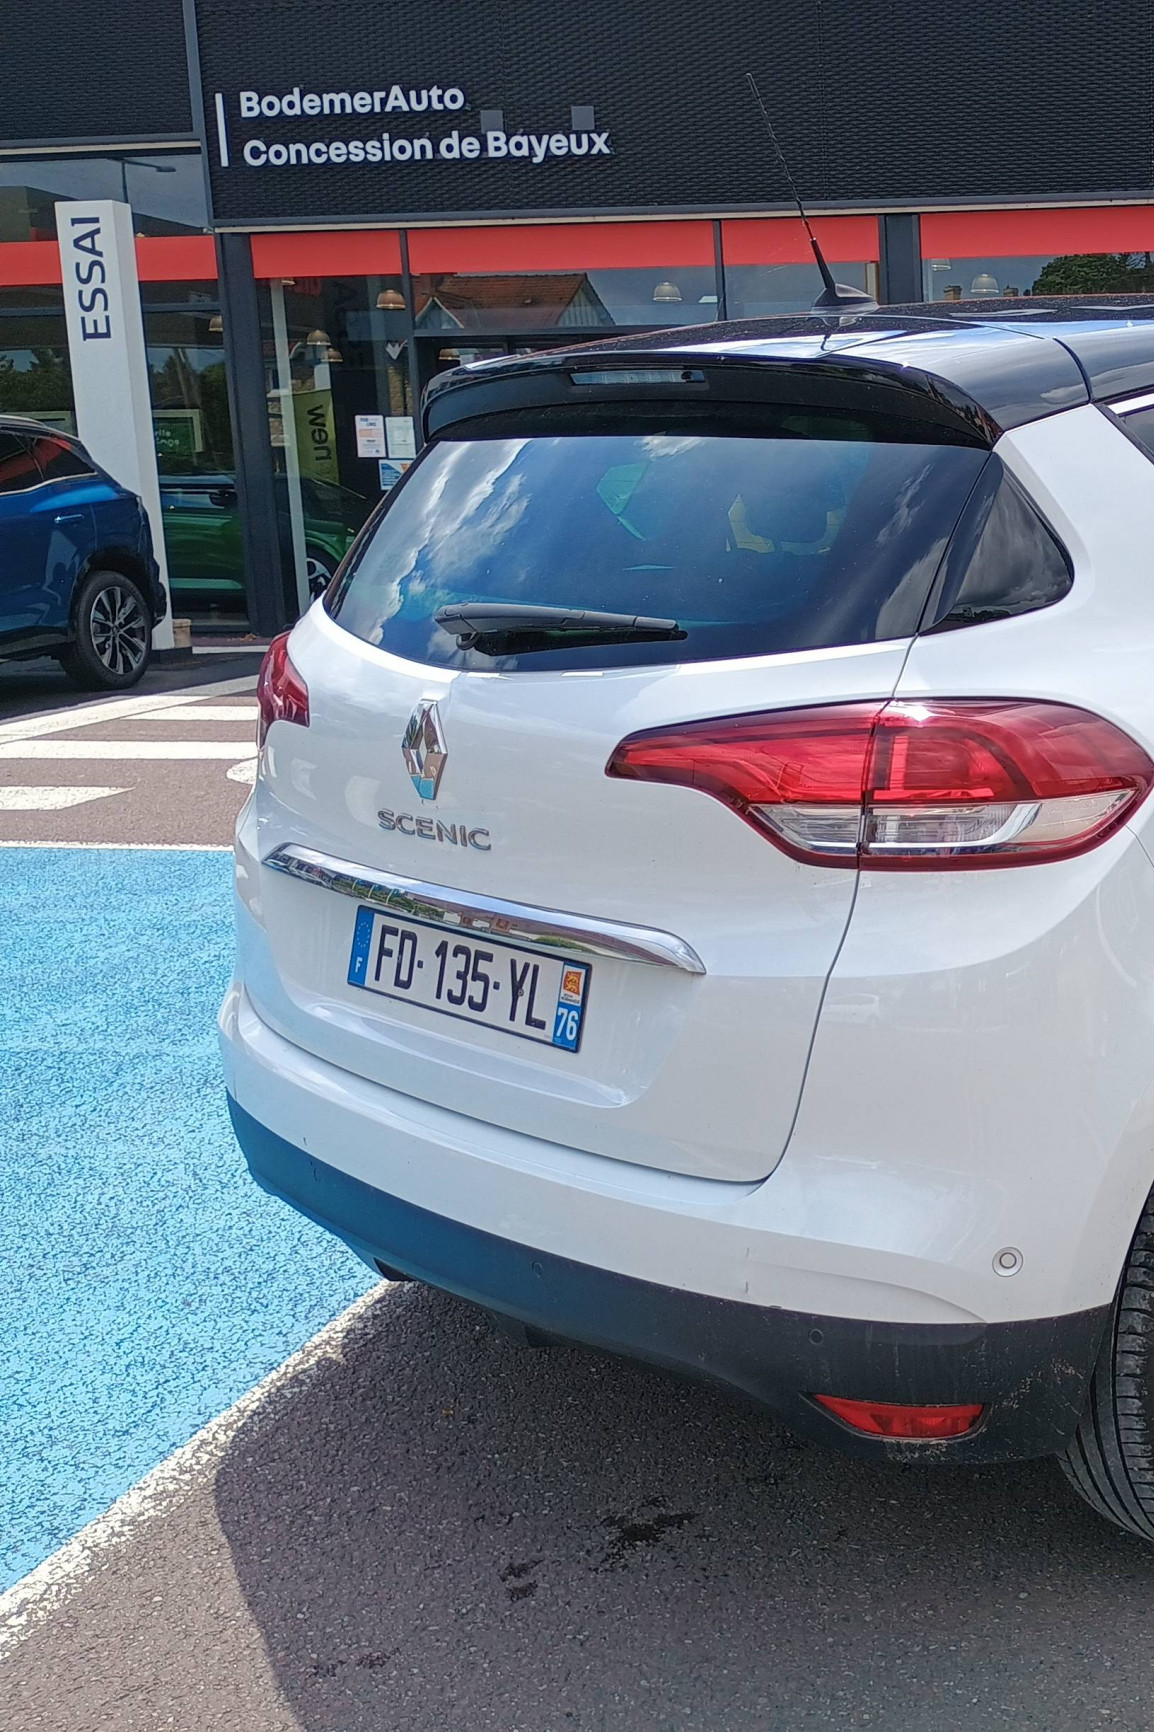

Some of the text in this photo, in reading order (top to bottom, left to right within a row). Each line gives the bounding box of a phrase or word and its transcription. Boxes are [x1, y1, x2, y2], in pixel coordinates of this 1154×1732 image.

[239, 84, 465, 118] BodemerAuto
[243, 130, 611, 166] Concession de Bayeux
[70, 216, 112, 342] ESSAI
[377, 808, 491, 851] SCENIC
[355, 923, 547, 1031] F FD-135-YL
[556, 1007, 579, 1041] 76
